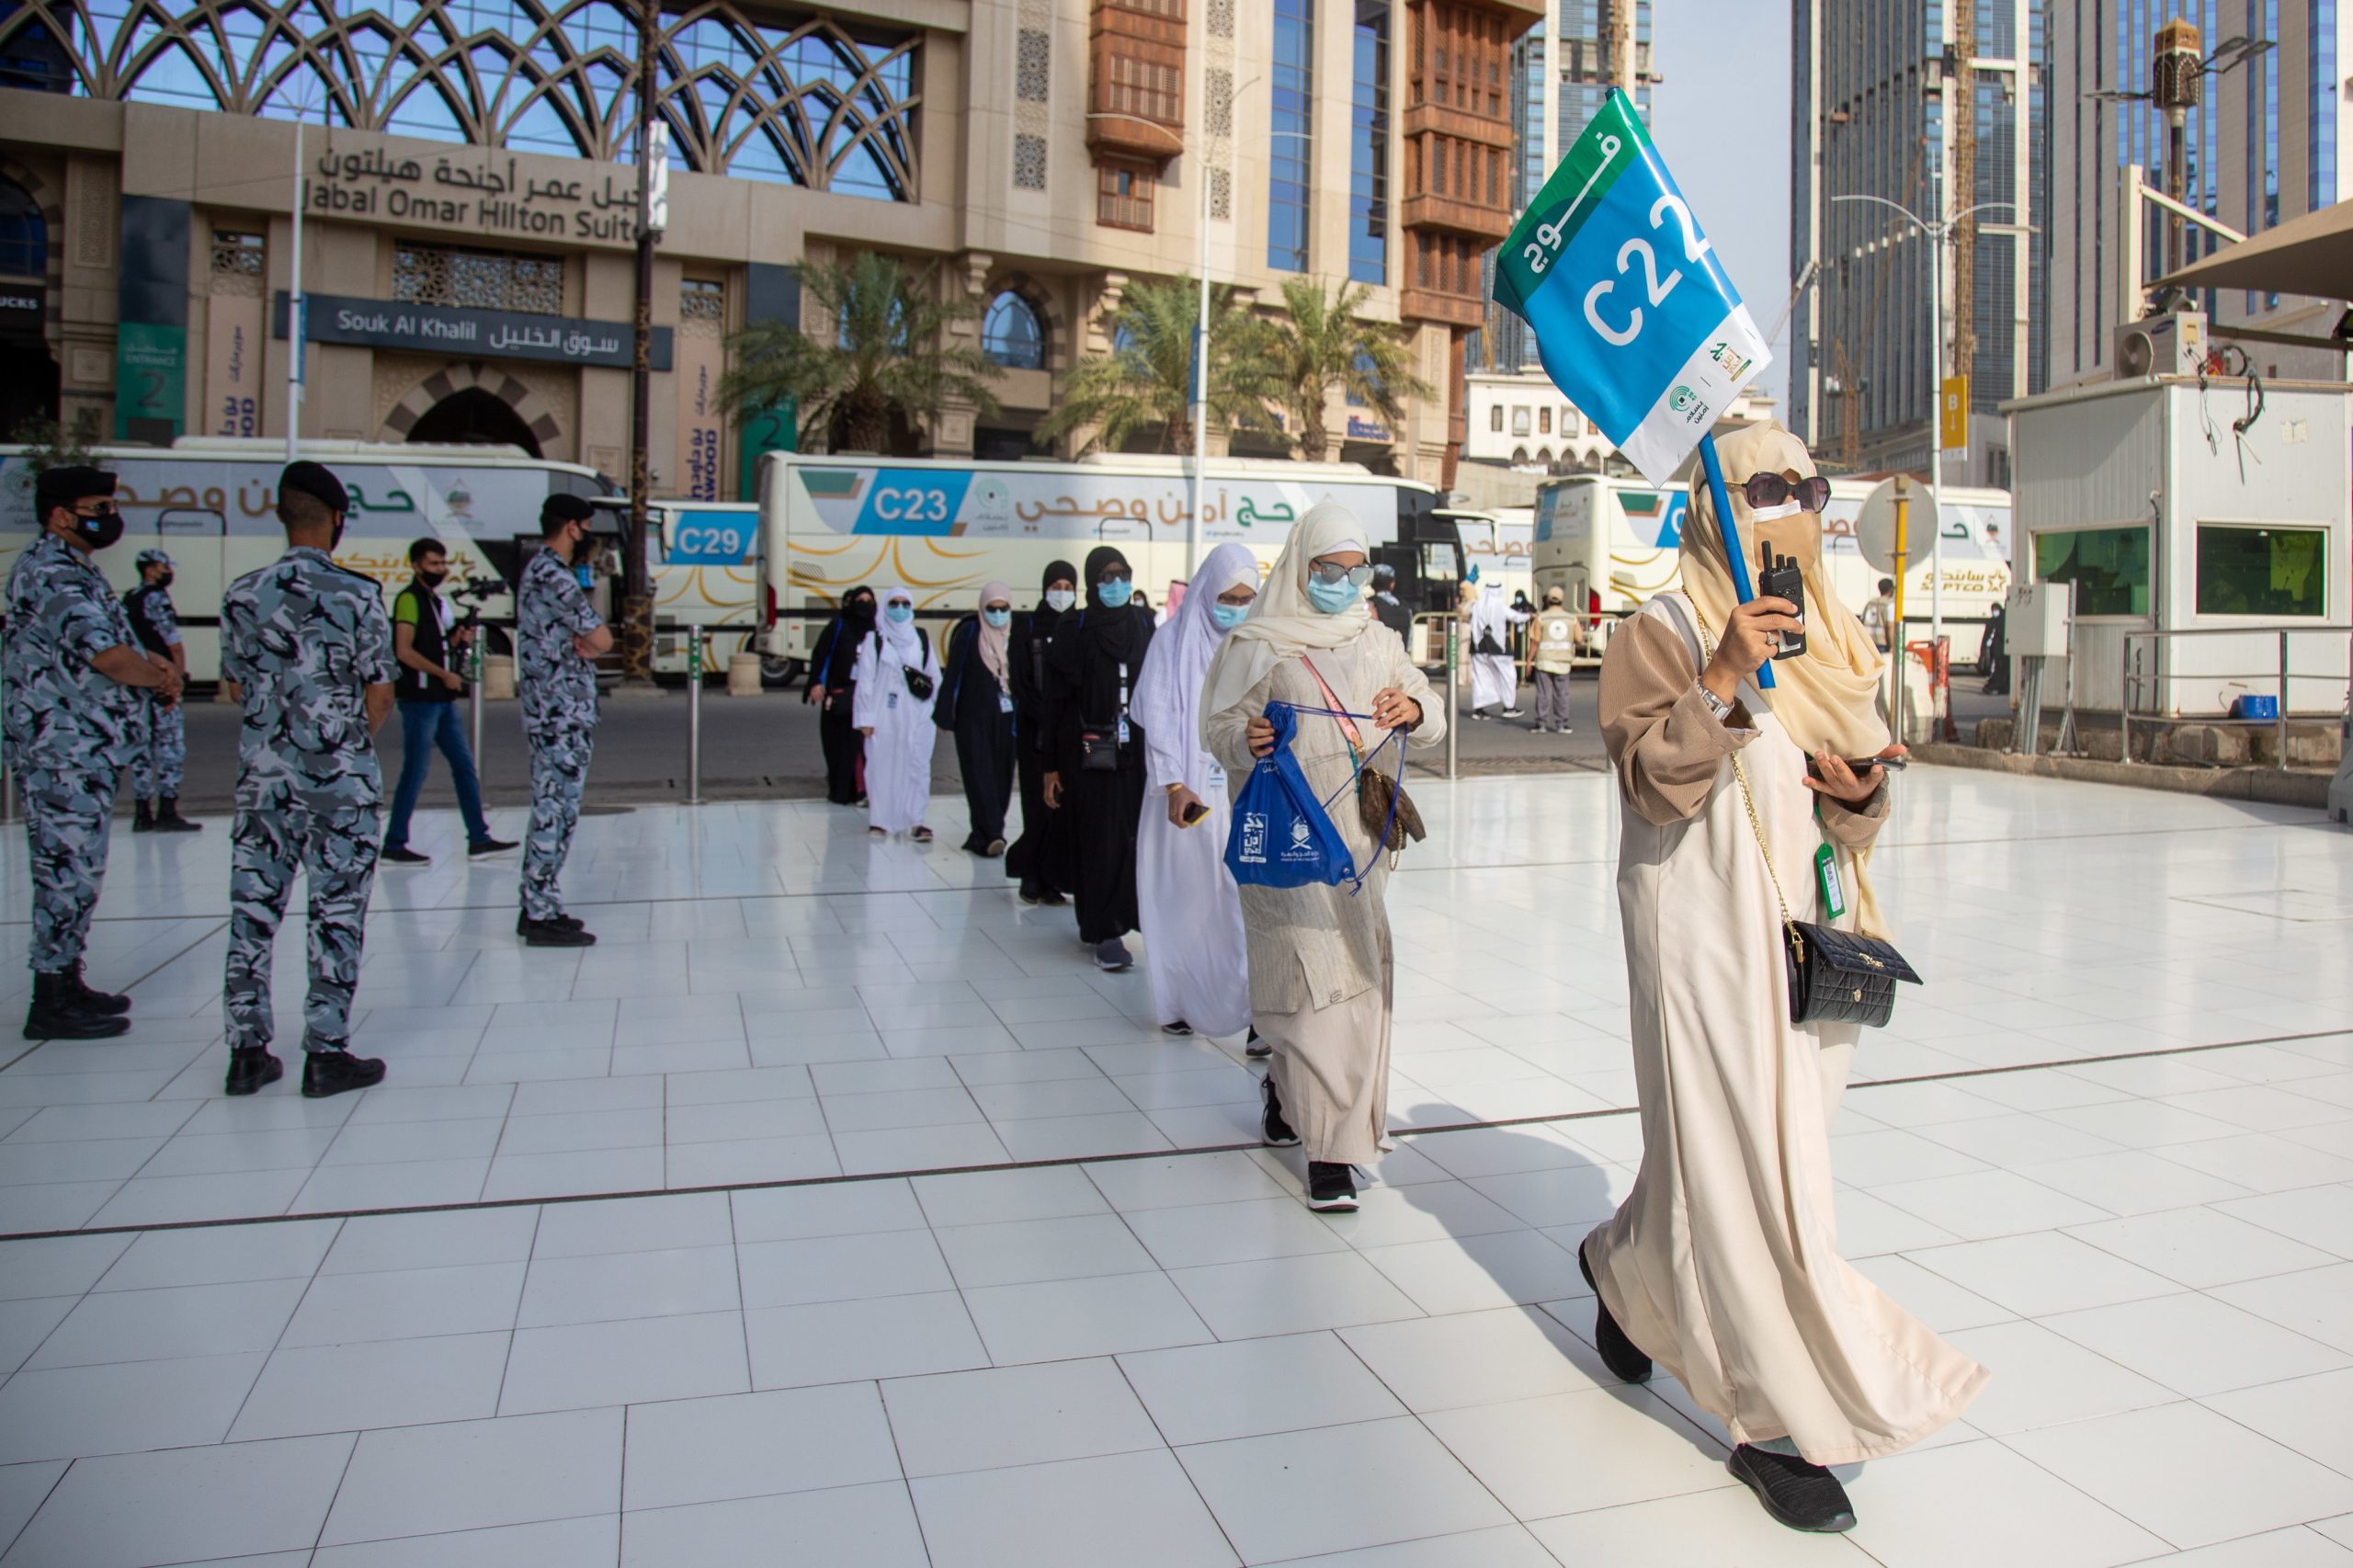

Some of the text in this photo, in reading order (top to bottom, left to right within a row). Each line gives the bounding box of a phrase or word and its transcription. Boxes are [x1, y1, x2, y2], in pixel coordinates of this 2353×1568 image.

[319, 147, 423, 183] هيلتون
[435, 157, 516, 194] أجنحة
[302, 178, 378, 214] Jabal
[388, 189, 468, 224] Omar
[478, 199, 565, 235] Hilton
[524, 179, 582, 204] عمر
[1523, 131, 1621, 274] فوج
[1583, 194, 1711, 347] C22
[337, 309, 476, 341] Souk Al Khalil
[489, 324, 620, 357] سوق الخليل
[759, 414, 781, 448] 2
[118, 483, 227, 516] وصح
[873, 487, 949, 523] C23
[1015, 494, 1149, 533] وصحي
[1236, 495, 1295, 528] حج
[677, 527, 741, 556] C29
[1921, 583, 1984, 593] SPTCO
